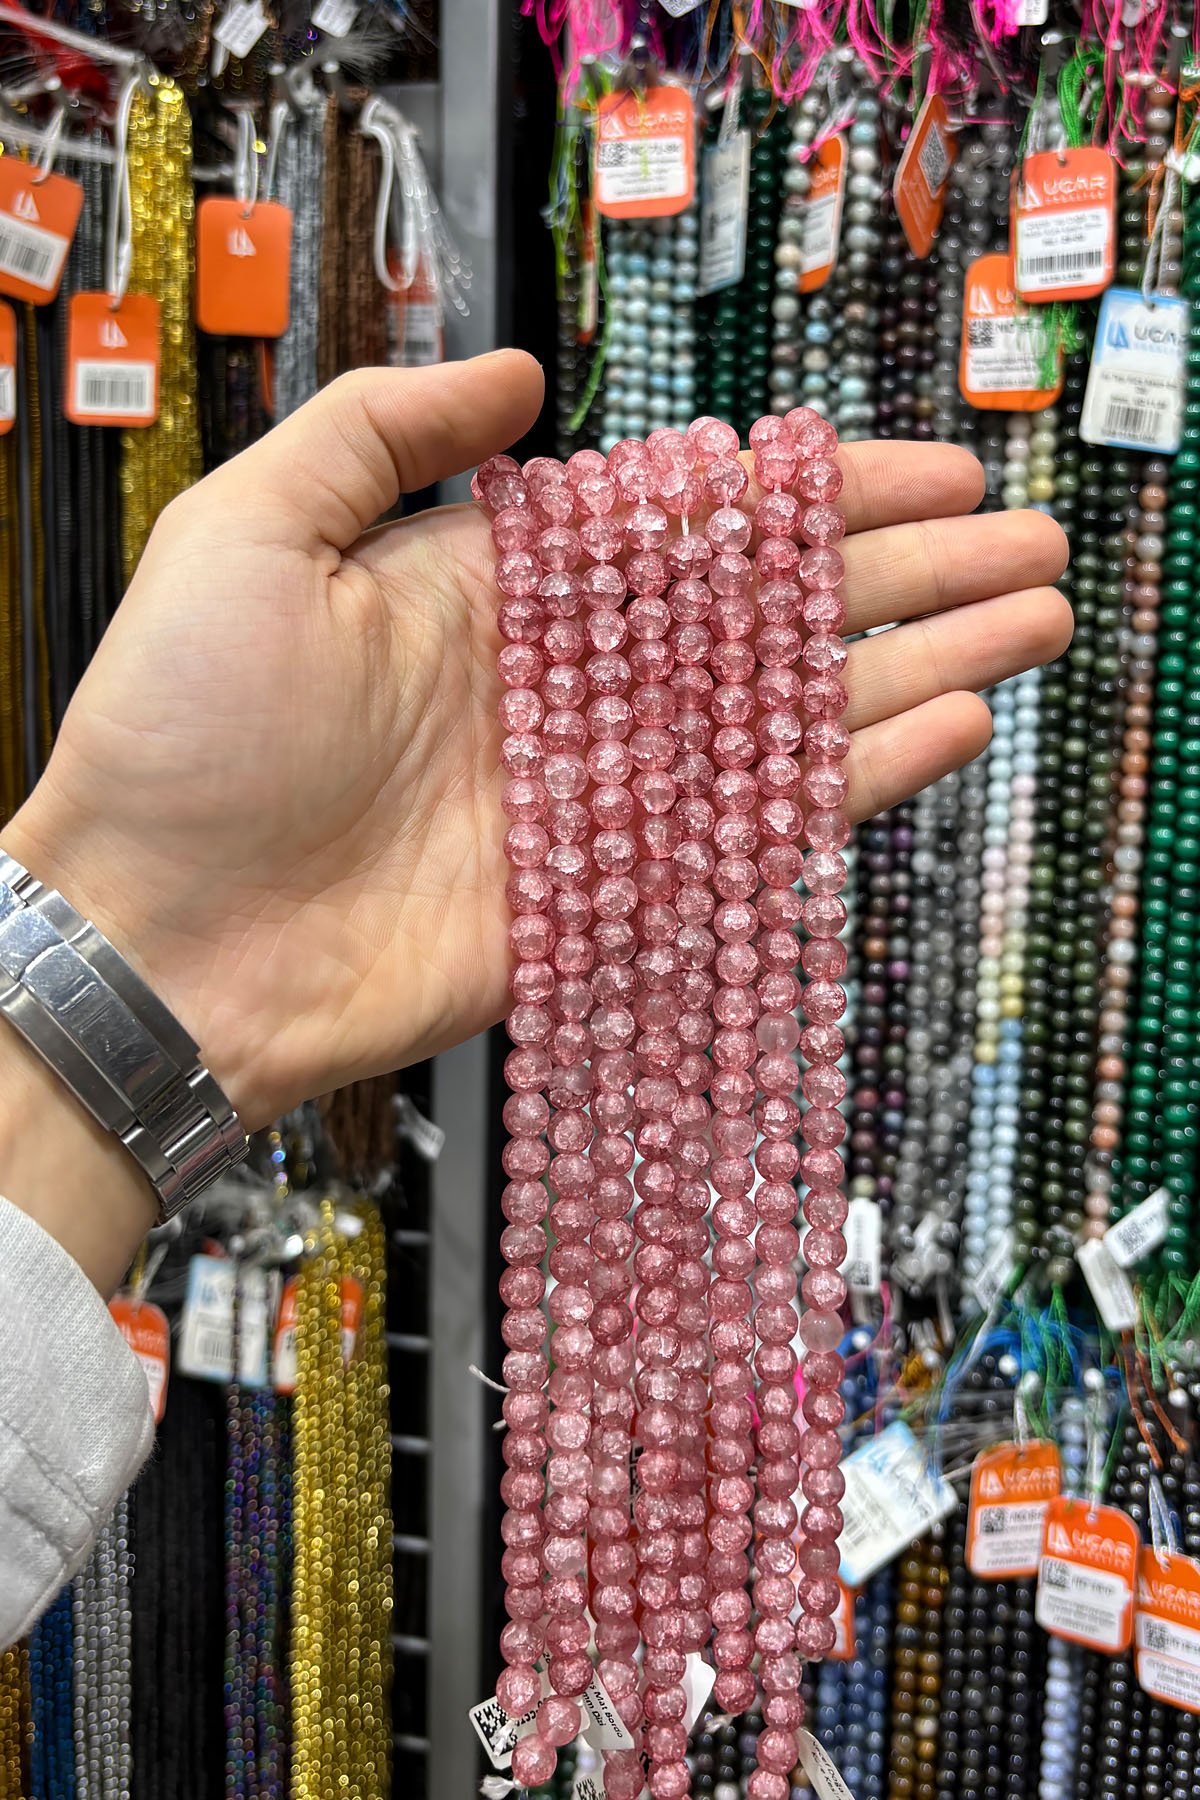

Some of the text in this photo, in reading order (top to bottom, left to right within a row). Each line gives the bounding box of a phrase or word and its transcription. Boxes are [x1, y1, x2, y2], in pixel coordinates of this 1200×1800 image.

[1042, 177, 1107, 196] UCAR
[1002, 1464, 1058, 1483] UCAR
[1071, 1528, 1133, 1557] UCAR
[592, 1710, 607, 1727] Dizi
[594, 1691, 608, 1710] Mat
[605, 1712, 623, 1738] Bordo
